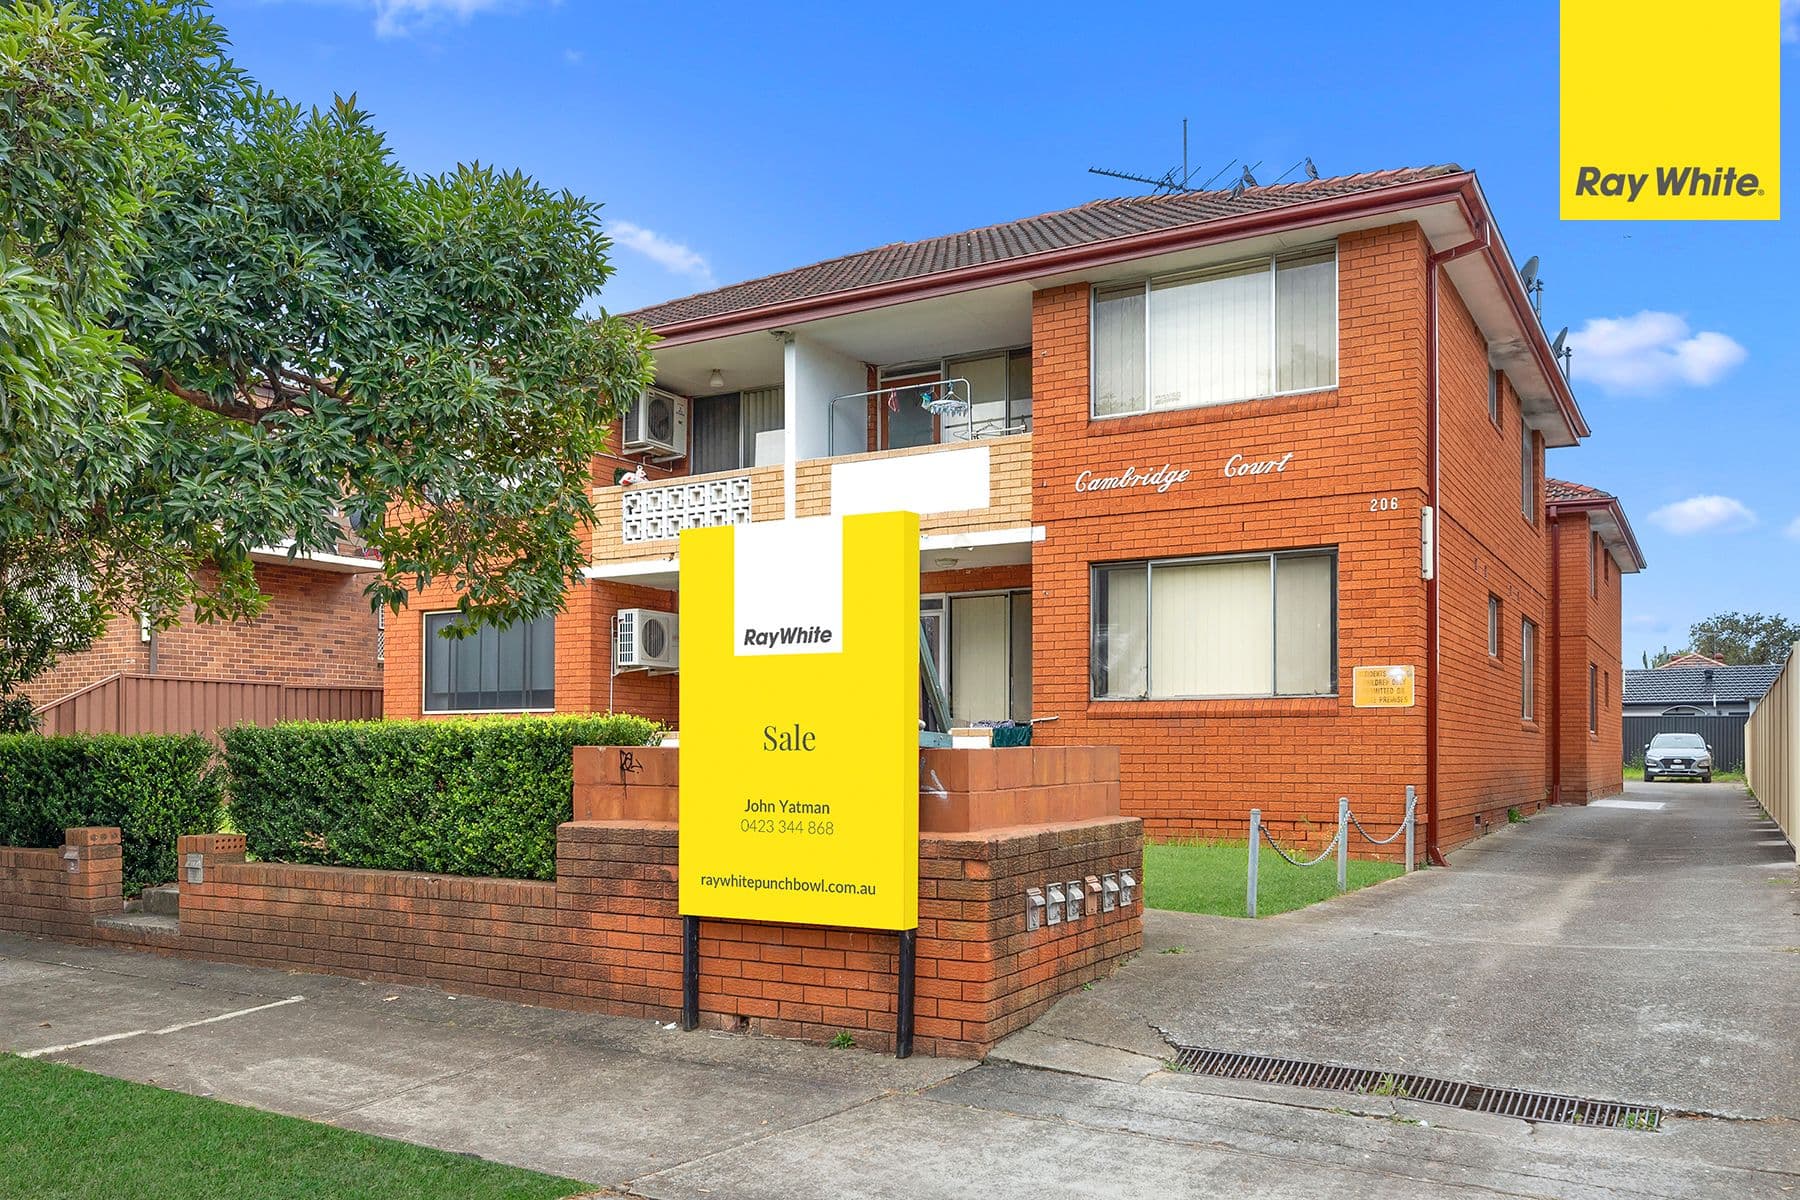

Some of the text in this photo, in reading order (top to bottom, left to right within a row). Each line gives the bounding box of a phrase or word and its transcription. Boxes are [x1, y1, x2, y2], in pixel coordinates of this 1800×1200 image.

[1074, 451, 1294, 493] Cambridge Court
[1370, 497, 1398, 512] 206
[763, 723, 817, 752] Sale
[744, 799, 830, 814] John Yatman
[740, 818, 834, 835] 0423 344 868
[700, 874, 876, 896] raywhitepunchbowl.com.au
